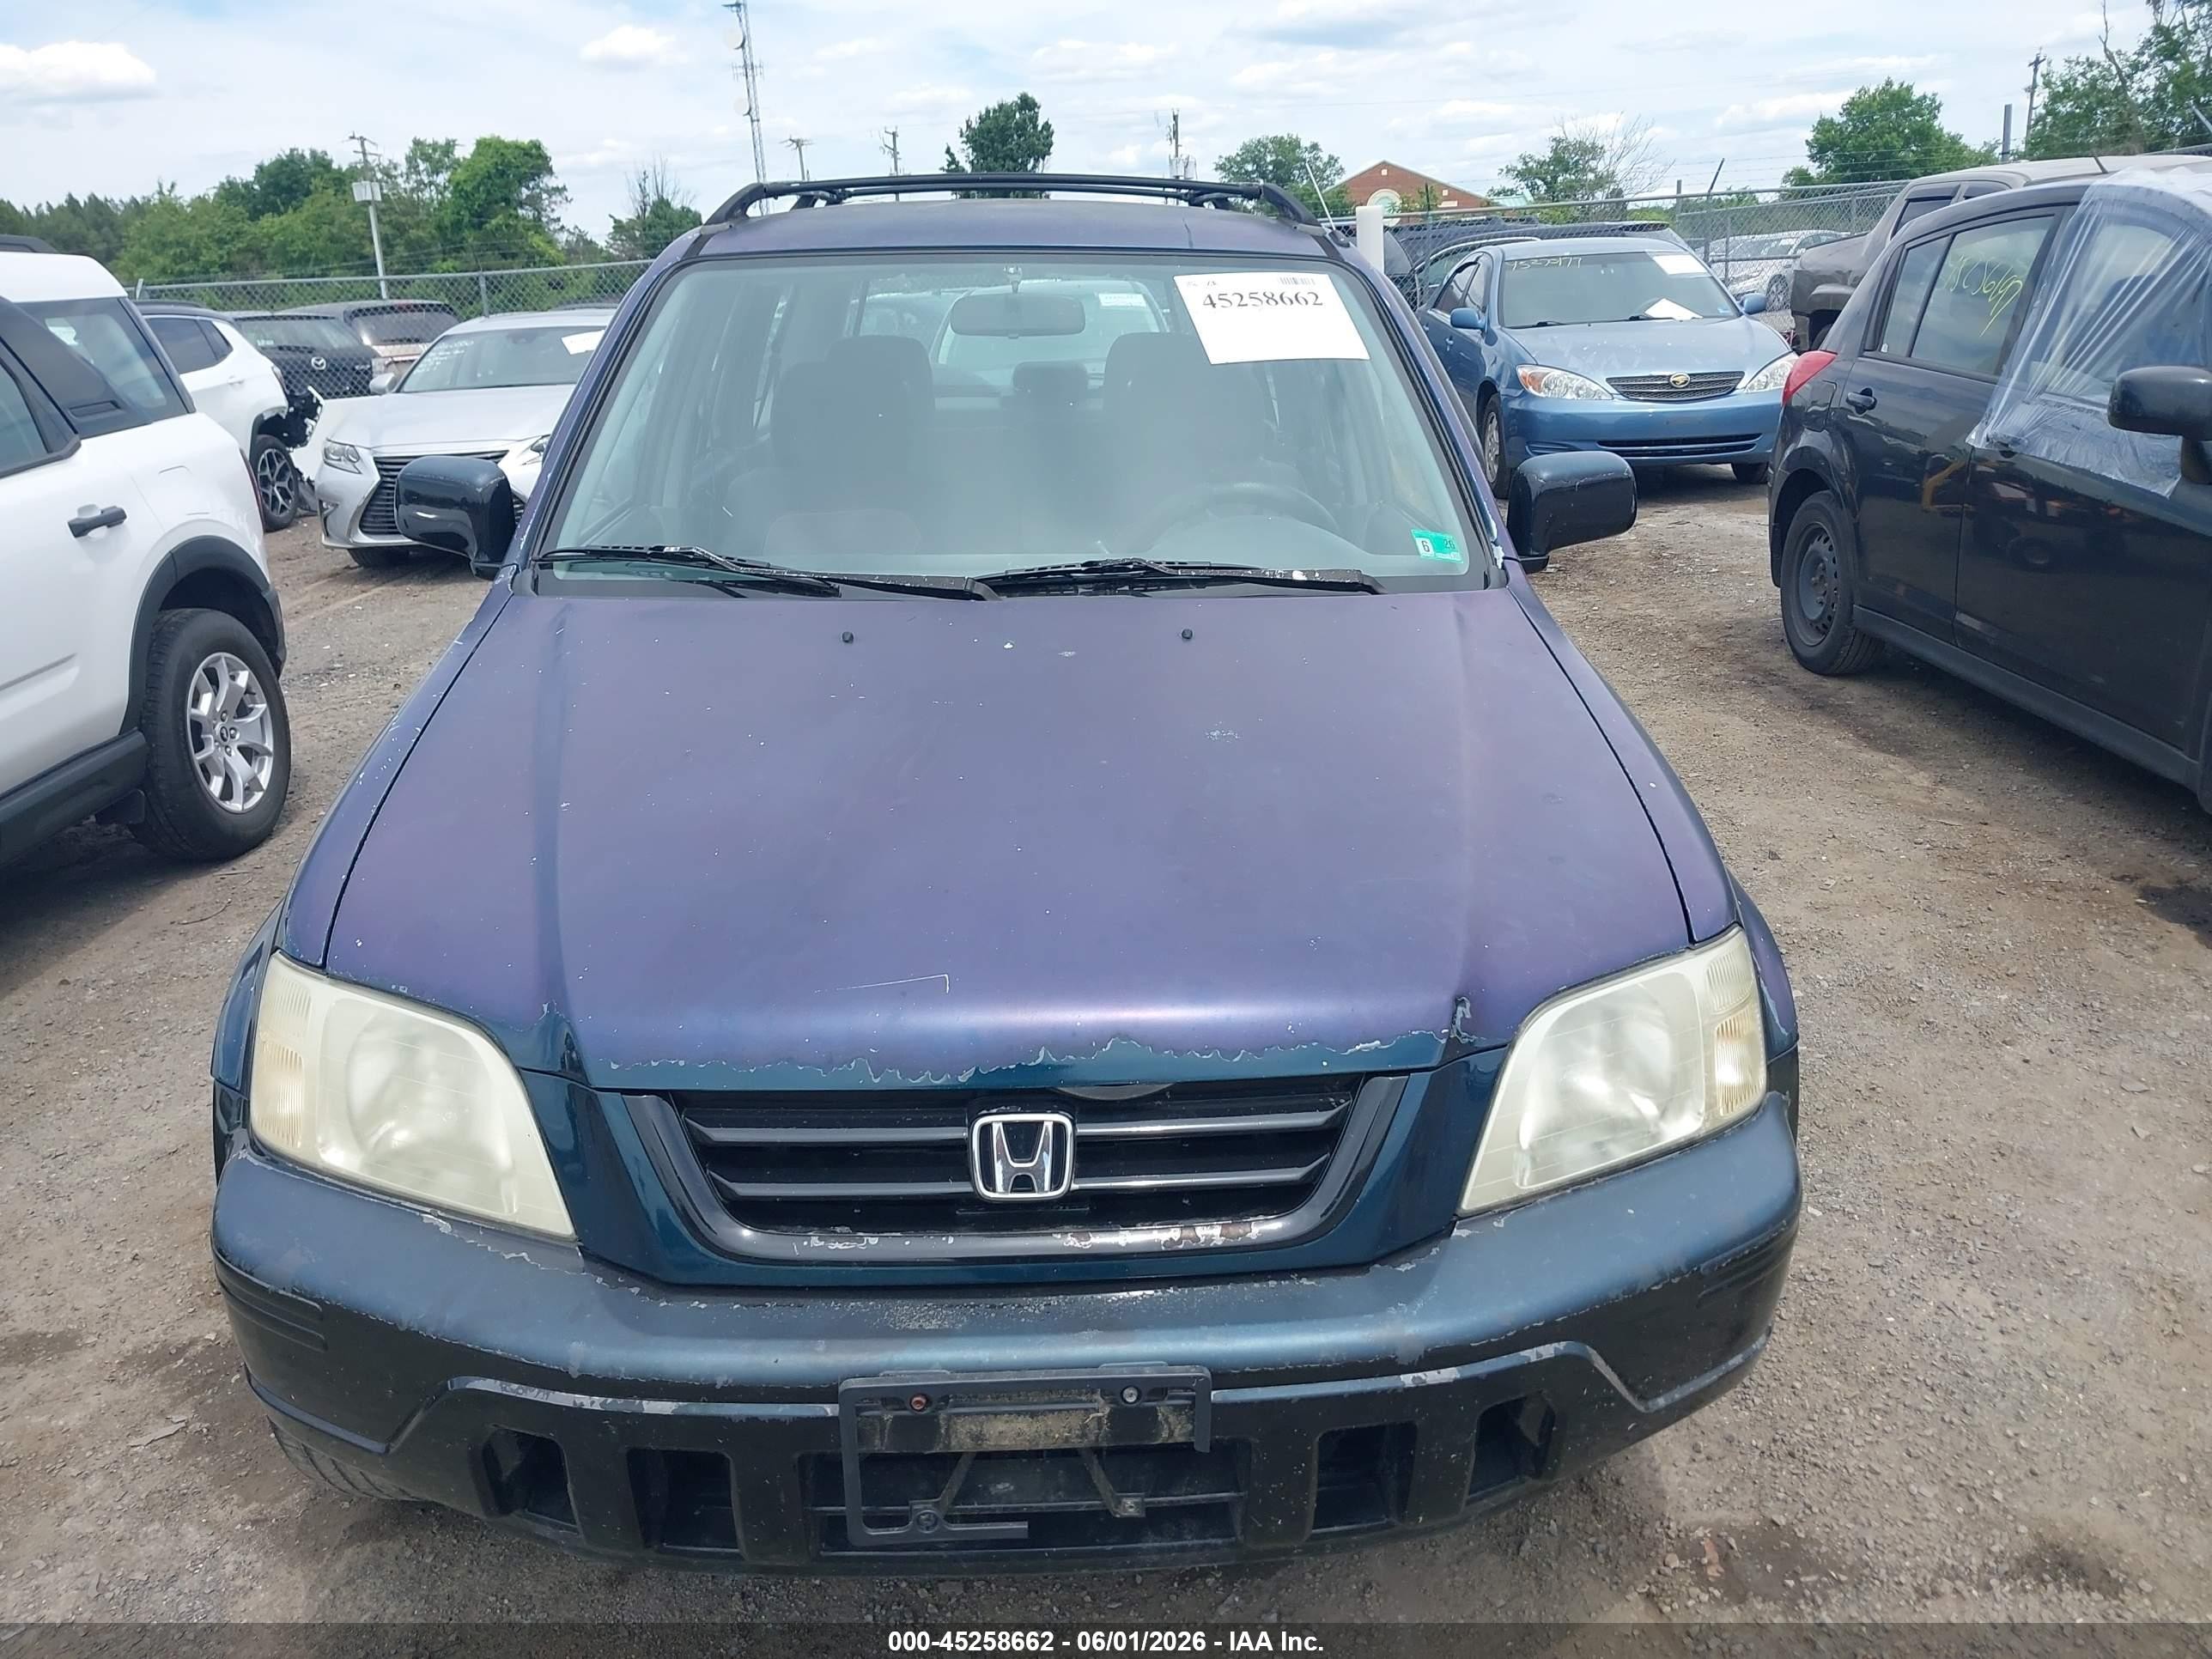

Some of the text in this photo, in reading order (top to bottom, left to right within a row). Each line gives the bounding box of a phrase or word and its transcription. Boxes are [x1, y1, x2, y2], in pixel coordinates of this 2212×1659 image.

[1202, 290, 1323, 308] 45258662
[1421, 538, 1455, 552] 6 26
